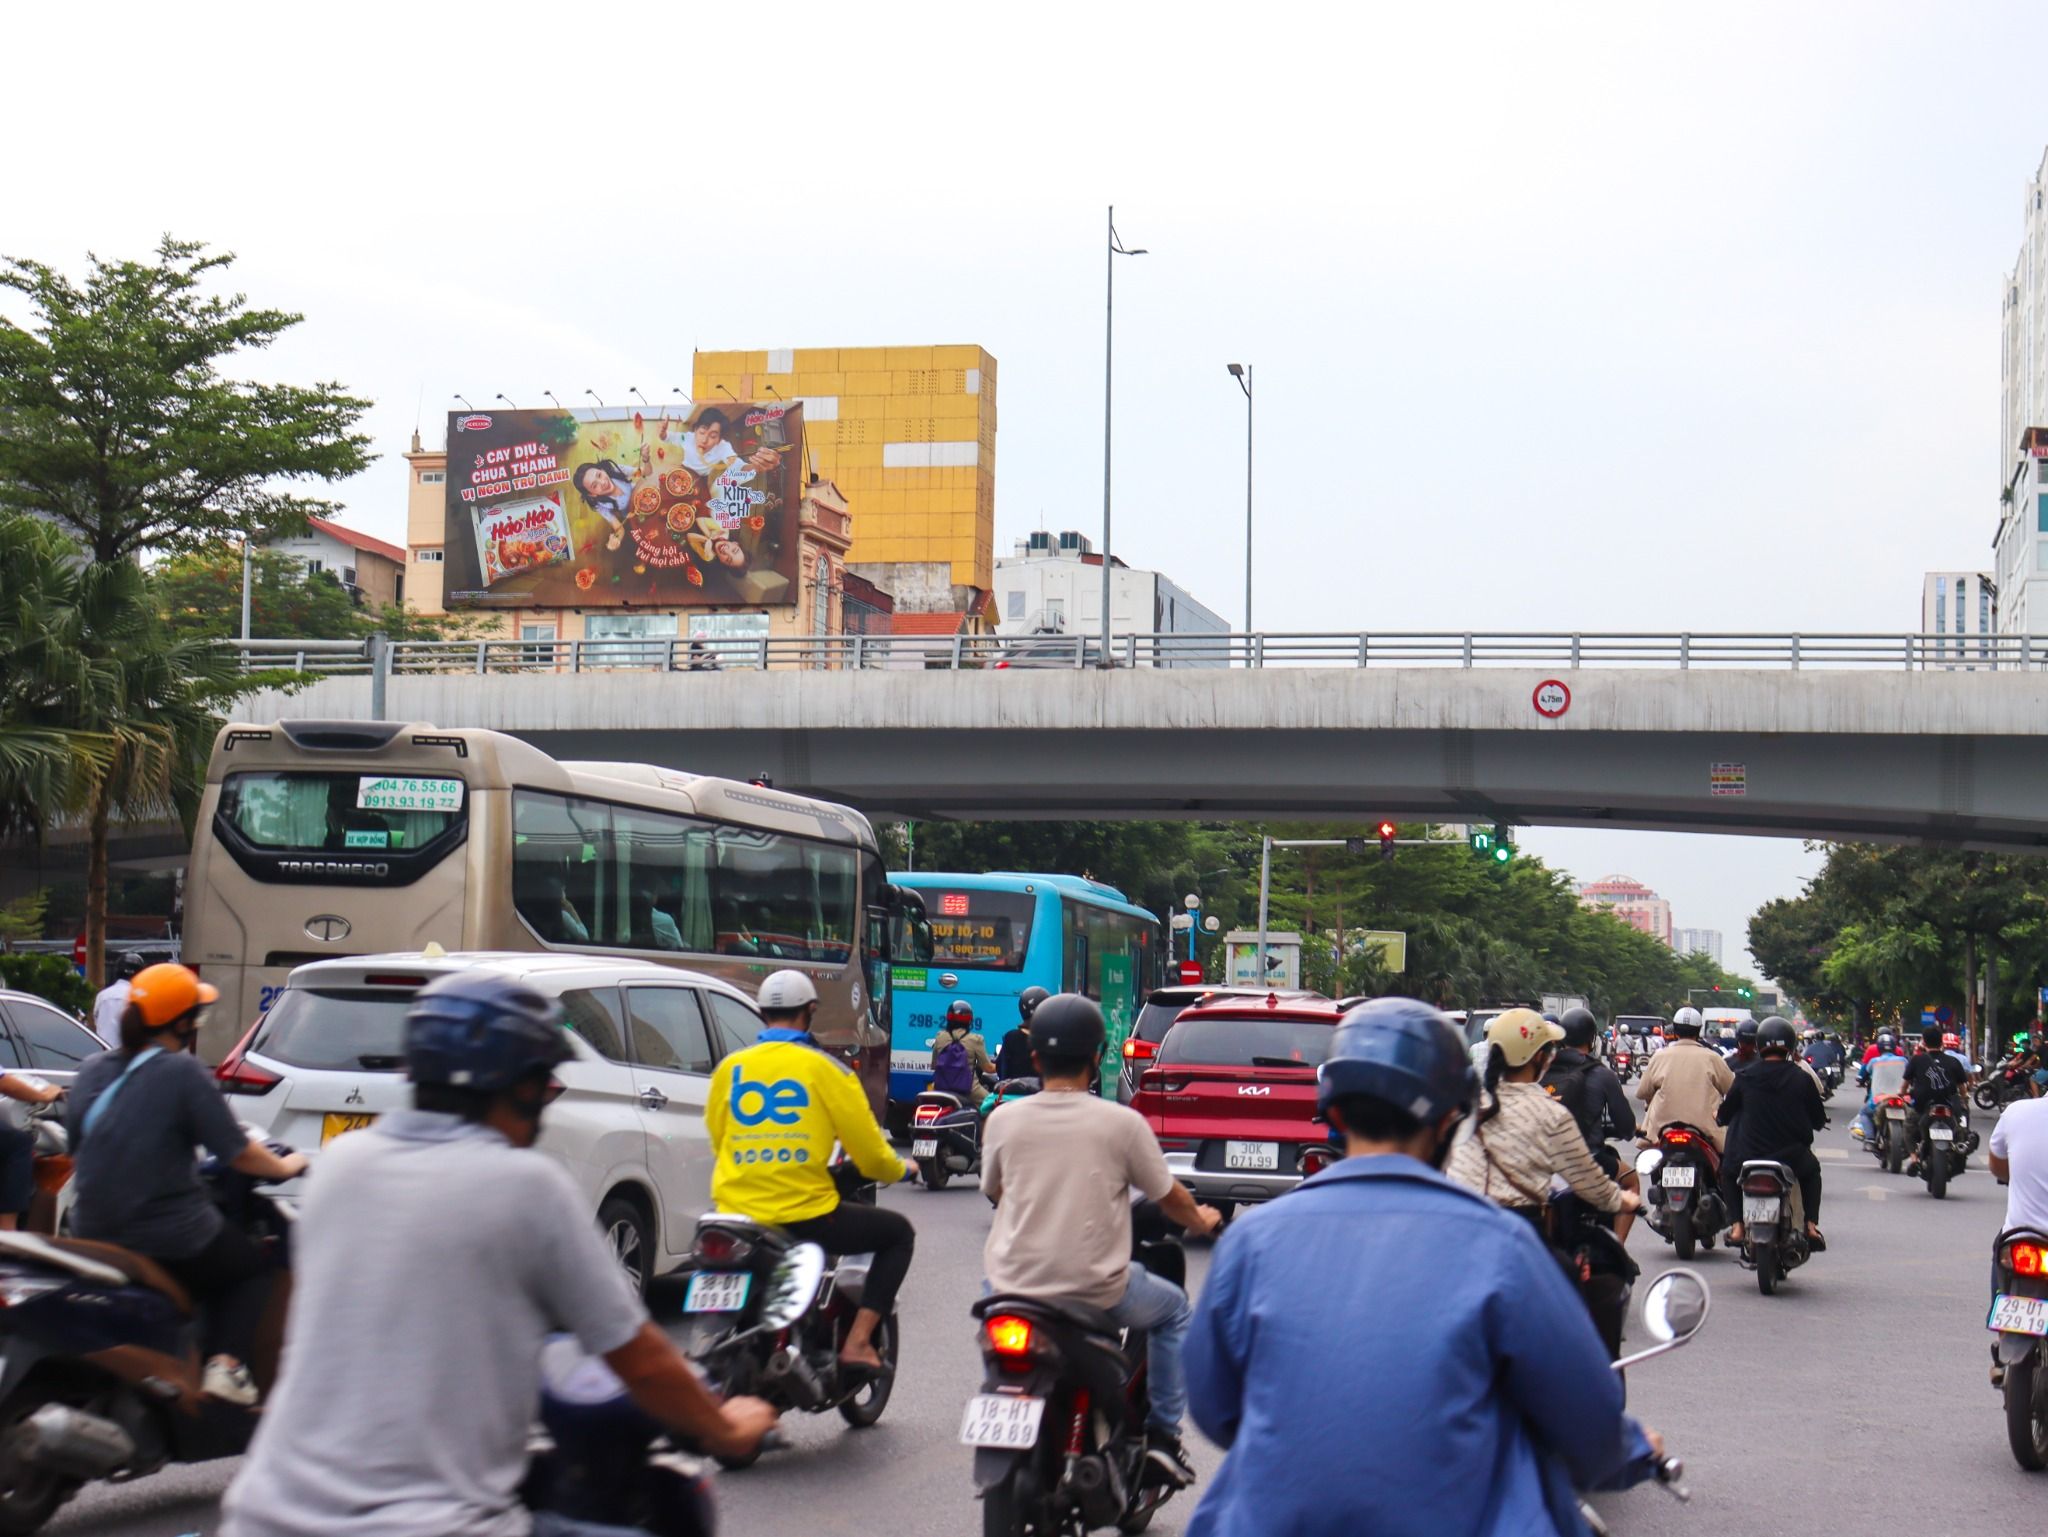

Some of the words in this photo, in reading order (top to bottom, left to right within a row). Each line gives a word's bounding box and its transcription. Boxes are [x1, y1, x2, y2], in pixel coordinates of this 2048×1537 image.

[486, 448, 511, 464] CAY
[514, 443, 537, 459] DỊU
[472, 466, 507, 483] CHUA
[511, 456, 557, 475] THANH
[461, 488, 475, 501] VỊ
[477, 481, 510, 498] NGON
[538, 468, 570, 486] DANH
[278, 861, 389, 877] TRACOMECO
[730, 1065, 809, 1126] be
[1241, 1143, 1263, 1154] 30K
[1231, 1155, 1272, 1167] 071.99
